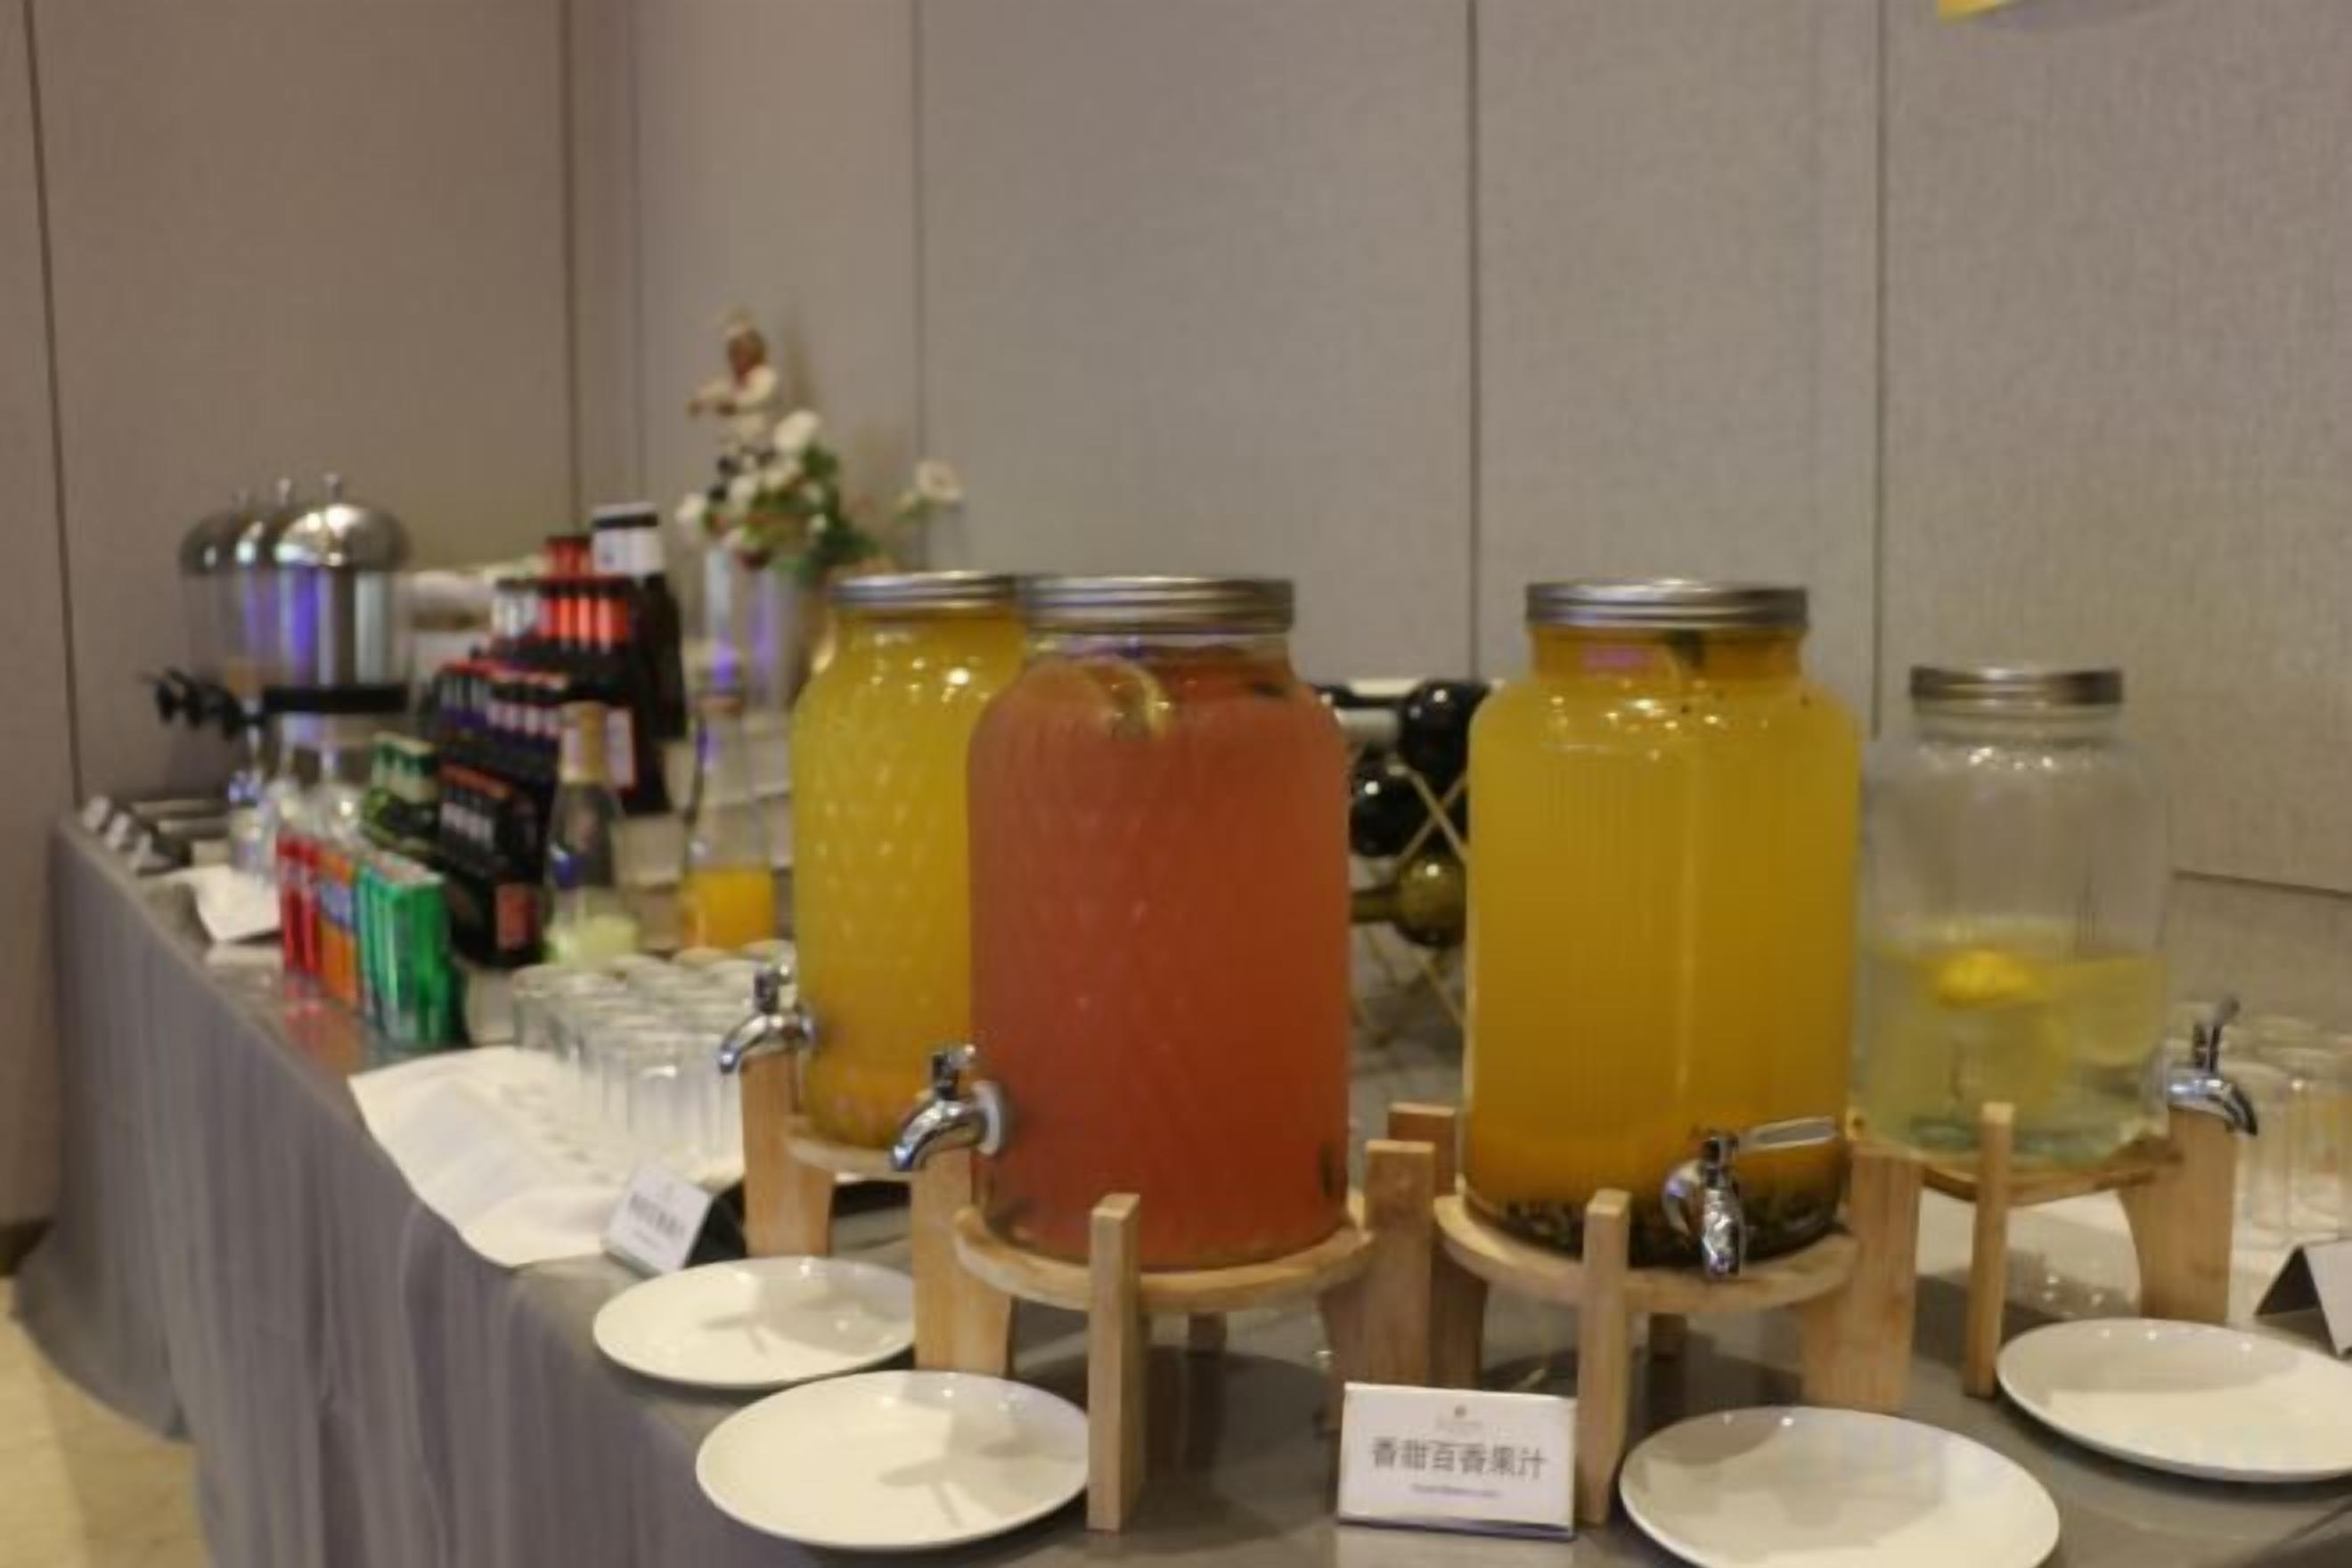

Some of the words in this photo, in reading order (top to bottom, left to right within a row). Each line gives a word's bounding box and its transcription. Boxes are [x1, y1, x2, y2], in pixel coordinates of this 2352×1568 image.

[1372, 1436, 1548, 1479] 香甜百香果汁
